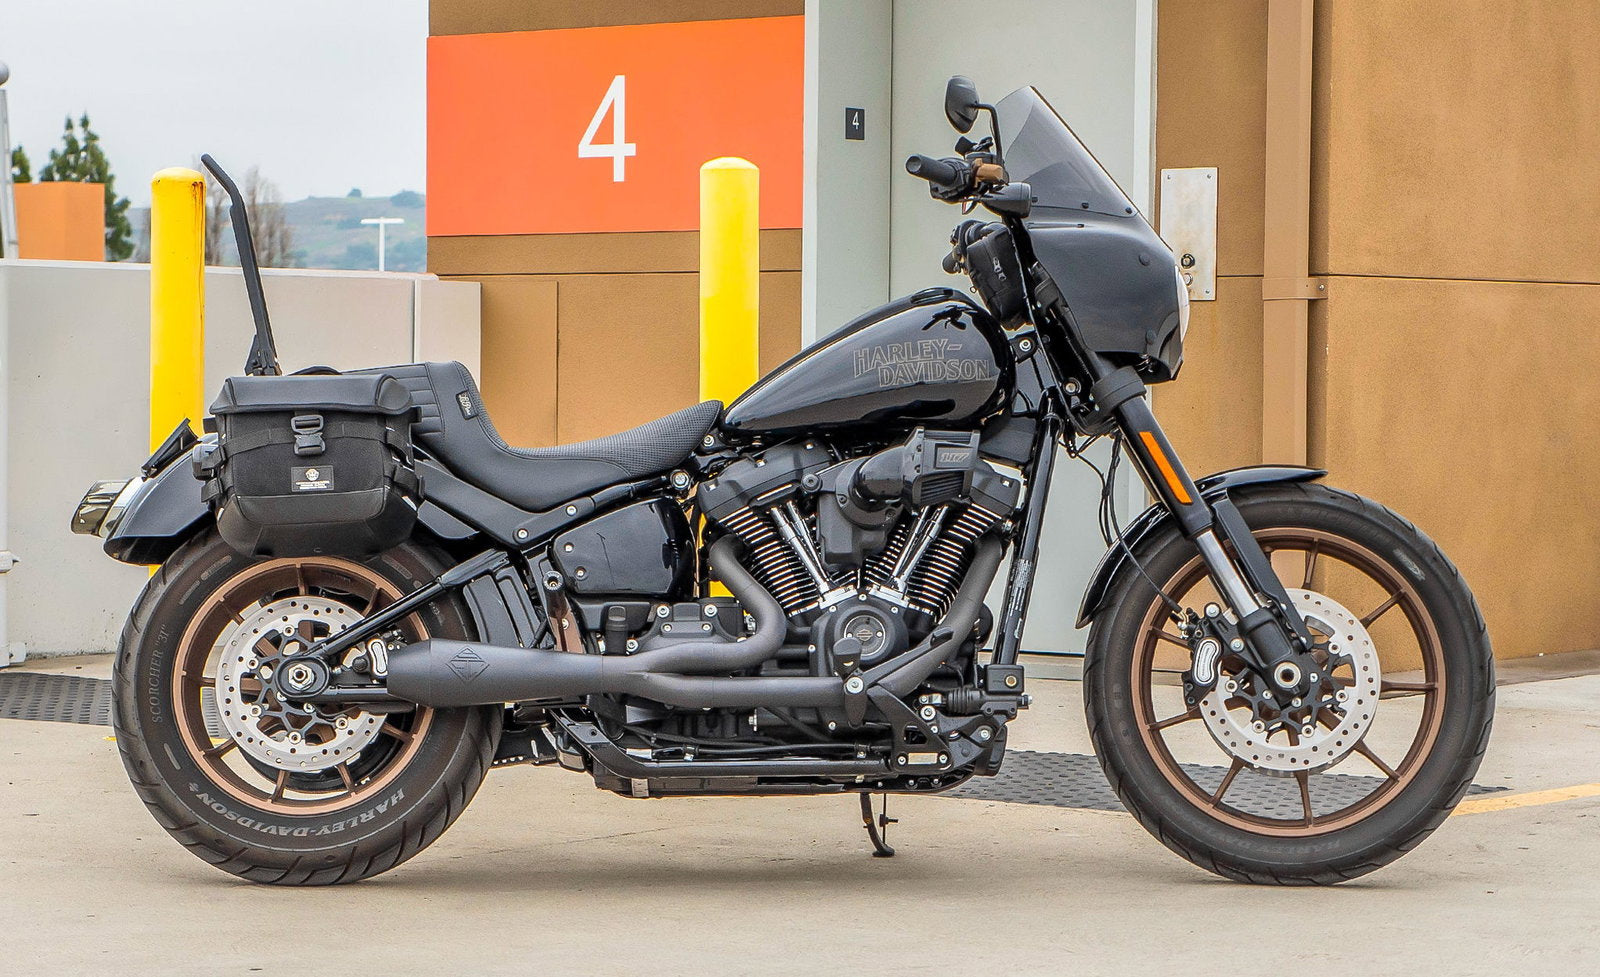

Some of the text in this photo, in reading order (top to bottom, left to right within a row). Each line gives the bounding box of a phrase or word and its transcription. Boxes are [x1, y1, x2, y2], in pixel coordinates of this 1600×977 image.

[578, 75, 636, 182] 4
[852, 111, 860, 130] 4
[853, 339, 963, 379] HARLEY-
[878, 359, 990, 387] DAVIDSON
[148, 652, 164, 723] SCORCHER
[196, 787, 406, 838] HARLEY-DAVIDSON
